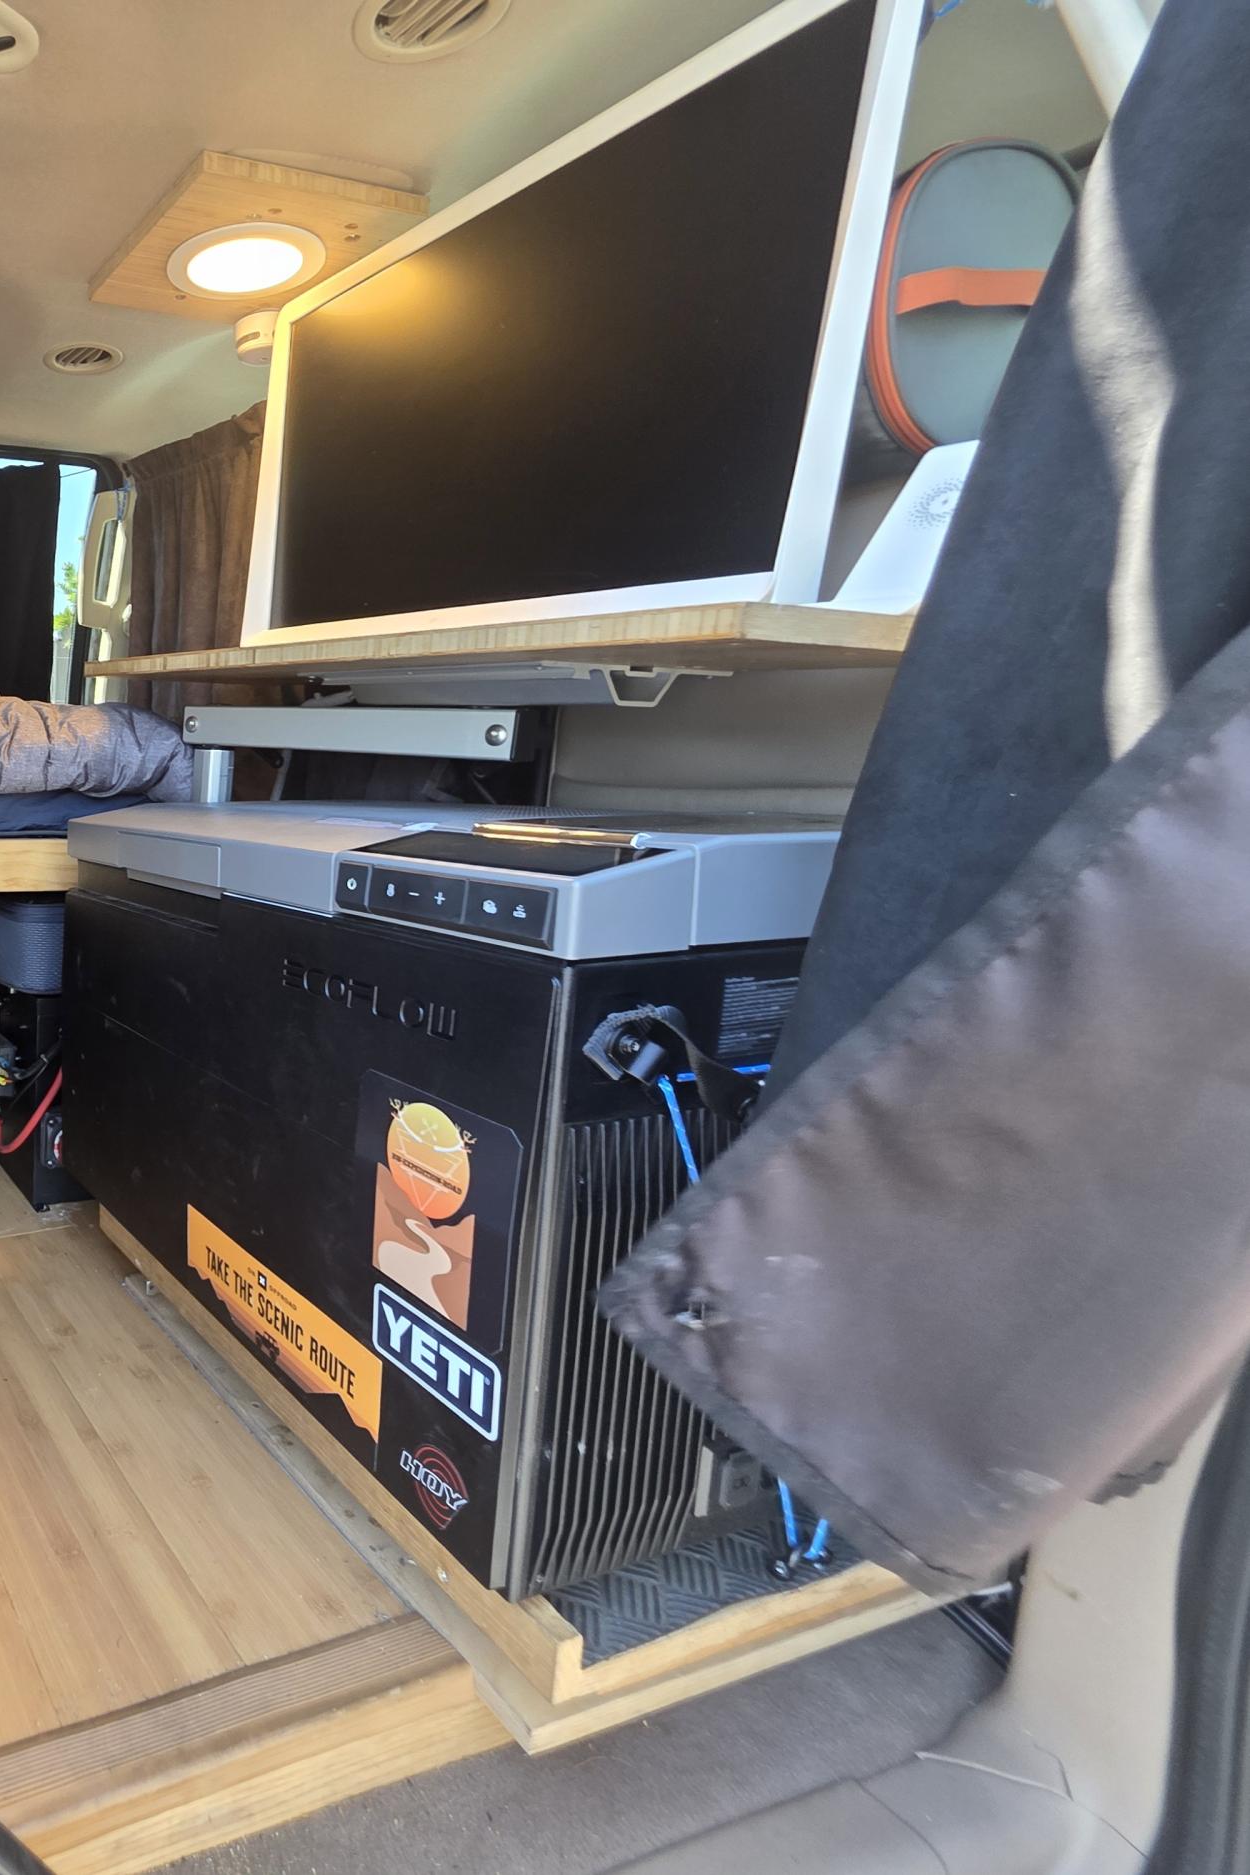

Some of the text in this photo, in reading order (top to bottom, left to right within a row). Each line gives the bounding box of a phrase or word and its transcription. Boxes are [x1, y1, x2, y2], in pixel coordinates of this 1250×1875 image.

[206, 1246, 356, 1399] TAKE THE SCENIC ROUTE
[381, 1301, 485, 1418] YETI
